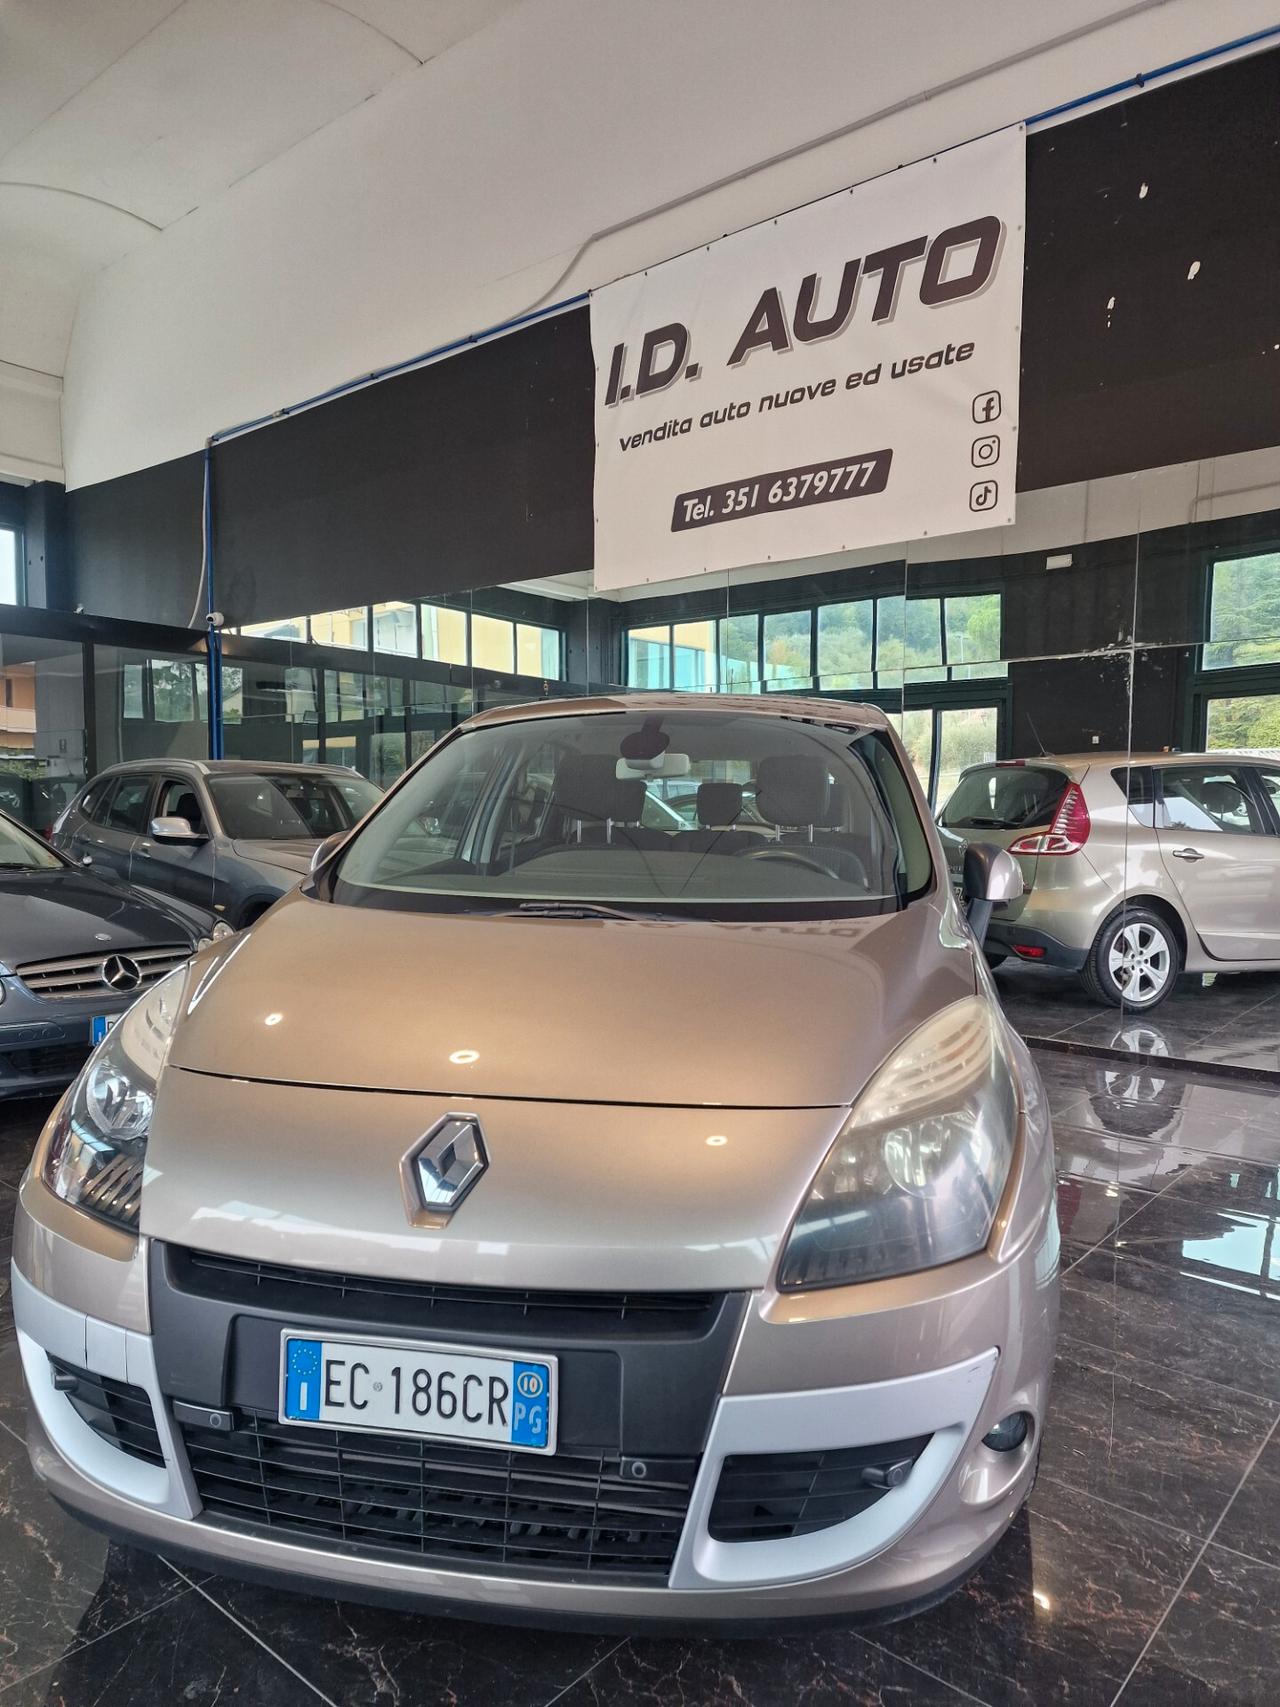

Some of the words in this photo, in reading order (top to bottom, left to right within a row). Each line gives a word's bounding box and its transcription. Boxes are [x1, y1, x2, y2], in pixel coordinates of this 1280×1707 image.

[604, 322, 700, 407] I.D.
[726, 215, 1004, 367] AUTO
[619, 418, 693, 452] vendita
[699, 402, 752, 428] auto
[758, 379, 837, 413] nuove
[845, 363, 882, 390] ed
[890, 342, 975, 379] usate
[683, 495, 714, 522] Tel.
[721, 484, 760, 514] 351
[768, 460, 877, 504] 6379777
[324, 1359, 370, 1410] EC
[391, 1366, 509, 1427] 186CR
[513, 1401, 542, 1434] PG
